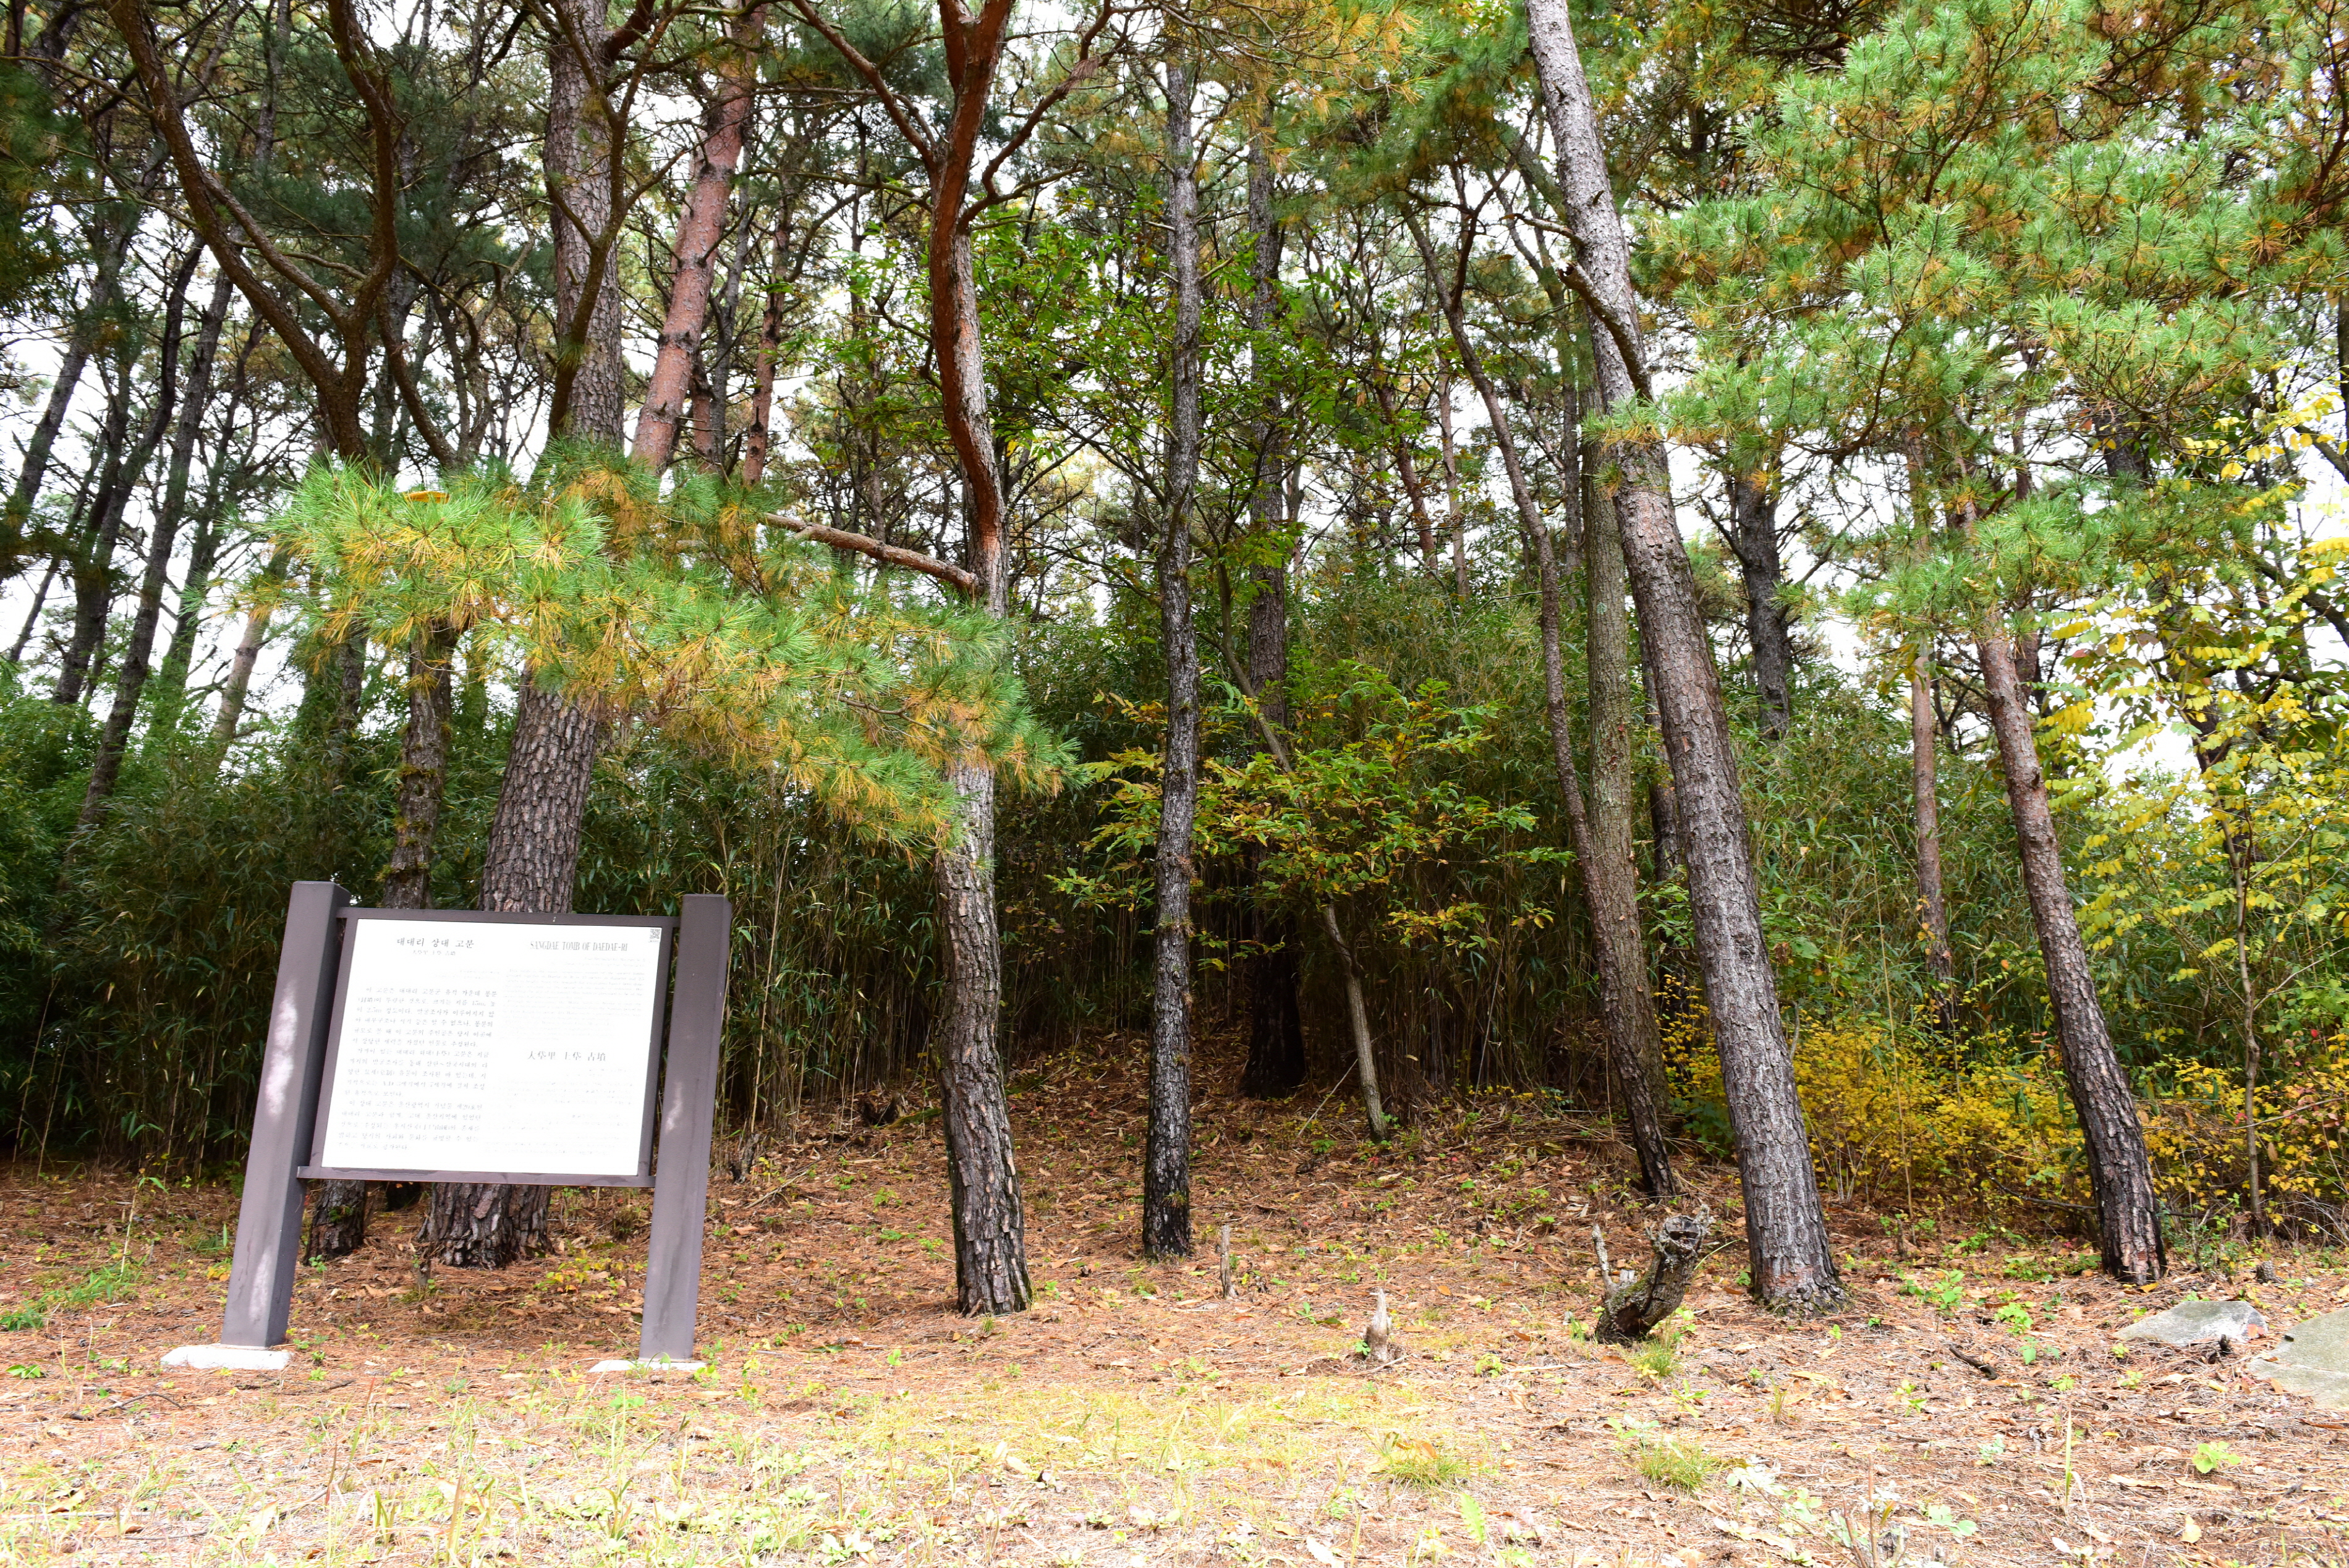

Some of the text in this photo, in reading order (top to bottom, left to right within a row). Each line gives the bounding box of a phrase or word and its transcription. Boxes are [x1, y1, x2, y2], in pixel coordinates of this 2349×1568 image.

[396, 936, 474, 949] 대대리 상대 고분
[530, 940, 628, 951] SANGDAE TOMB OF DAEDAE-RI
